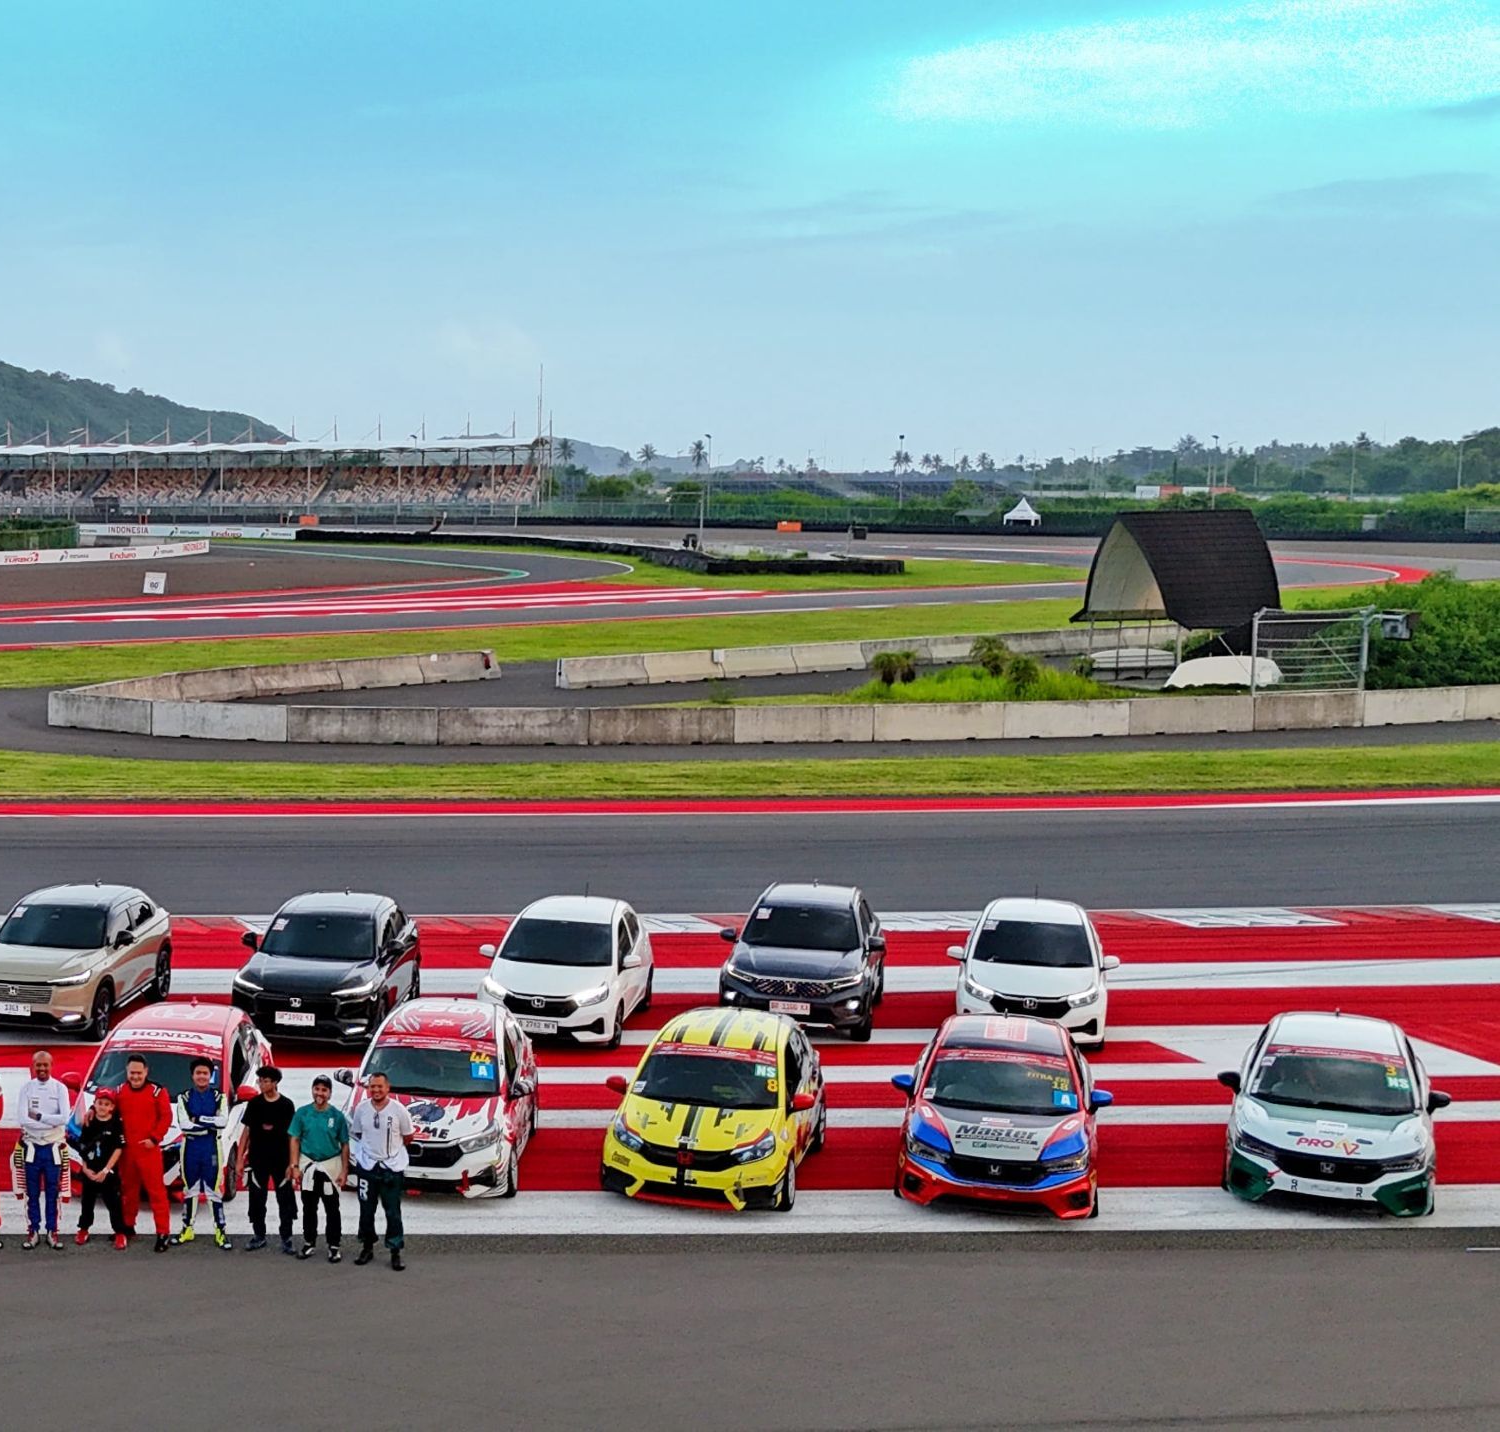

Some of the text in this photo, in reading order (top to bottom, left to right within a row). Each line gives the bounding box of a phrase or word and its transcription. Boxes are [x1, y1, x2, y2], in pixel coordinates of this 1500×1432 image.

[108, 526, 148, 534] INDONESIA
[183, 541, 206, 552] INDONESIA
[4, 556, 33, 564] TURBO
[109, 552, 136, 560] Enduro
[132, 1031, 204, 1041] HONDA
[477, 1065, 488, 1076] A
[756, 1065, 776, 1078] NS
[1386, 1065, 1397, 1076] 3
[767, 1079, 778, 1092] 8
[1387, 1076, 1410, 1089] NS
[1061, 1094, 1071, 1106] A
[956, 1124, 1039, 1140] Master
[1296, 1137, 1334, 1149] PRO
